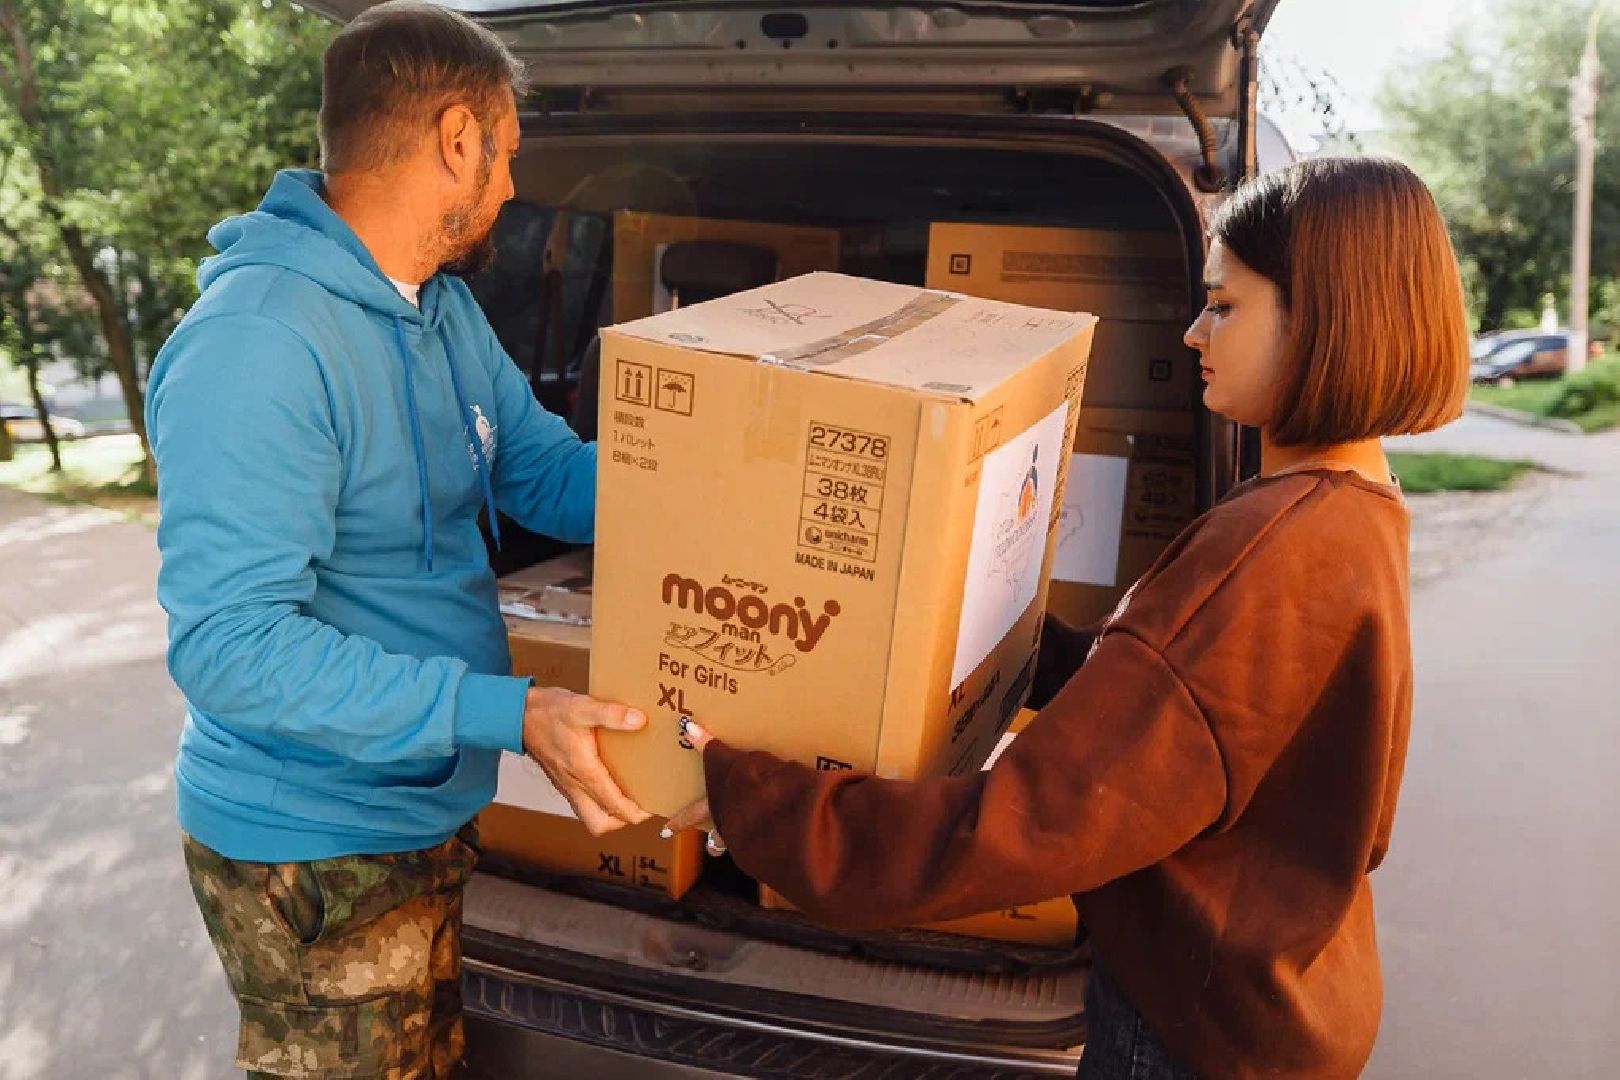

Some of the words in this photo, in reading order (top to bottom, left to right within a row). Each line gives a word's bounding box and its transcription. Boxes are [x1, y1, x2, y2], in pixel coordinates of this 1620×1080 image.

[810, 426, 887, 458] 27378
[817, 478, 868, 503] 38枚
[813, 502, 865, 528] 4袋入
[795, 551, 825, 570] MADE
[826, 560, 838, 572] IN
[839, 562, 875, 582] JAPAN
[662, 573, 841, 652] moony
[721, 622, 761, 644] man
[658, 652, 690, 679] For
[694, 664, 739, 694] Girls
[657, 682, 694, 716] XL
[598, 851, 625, 877] XL
